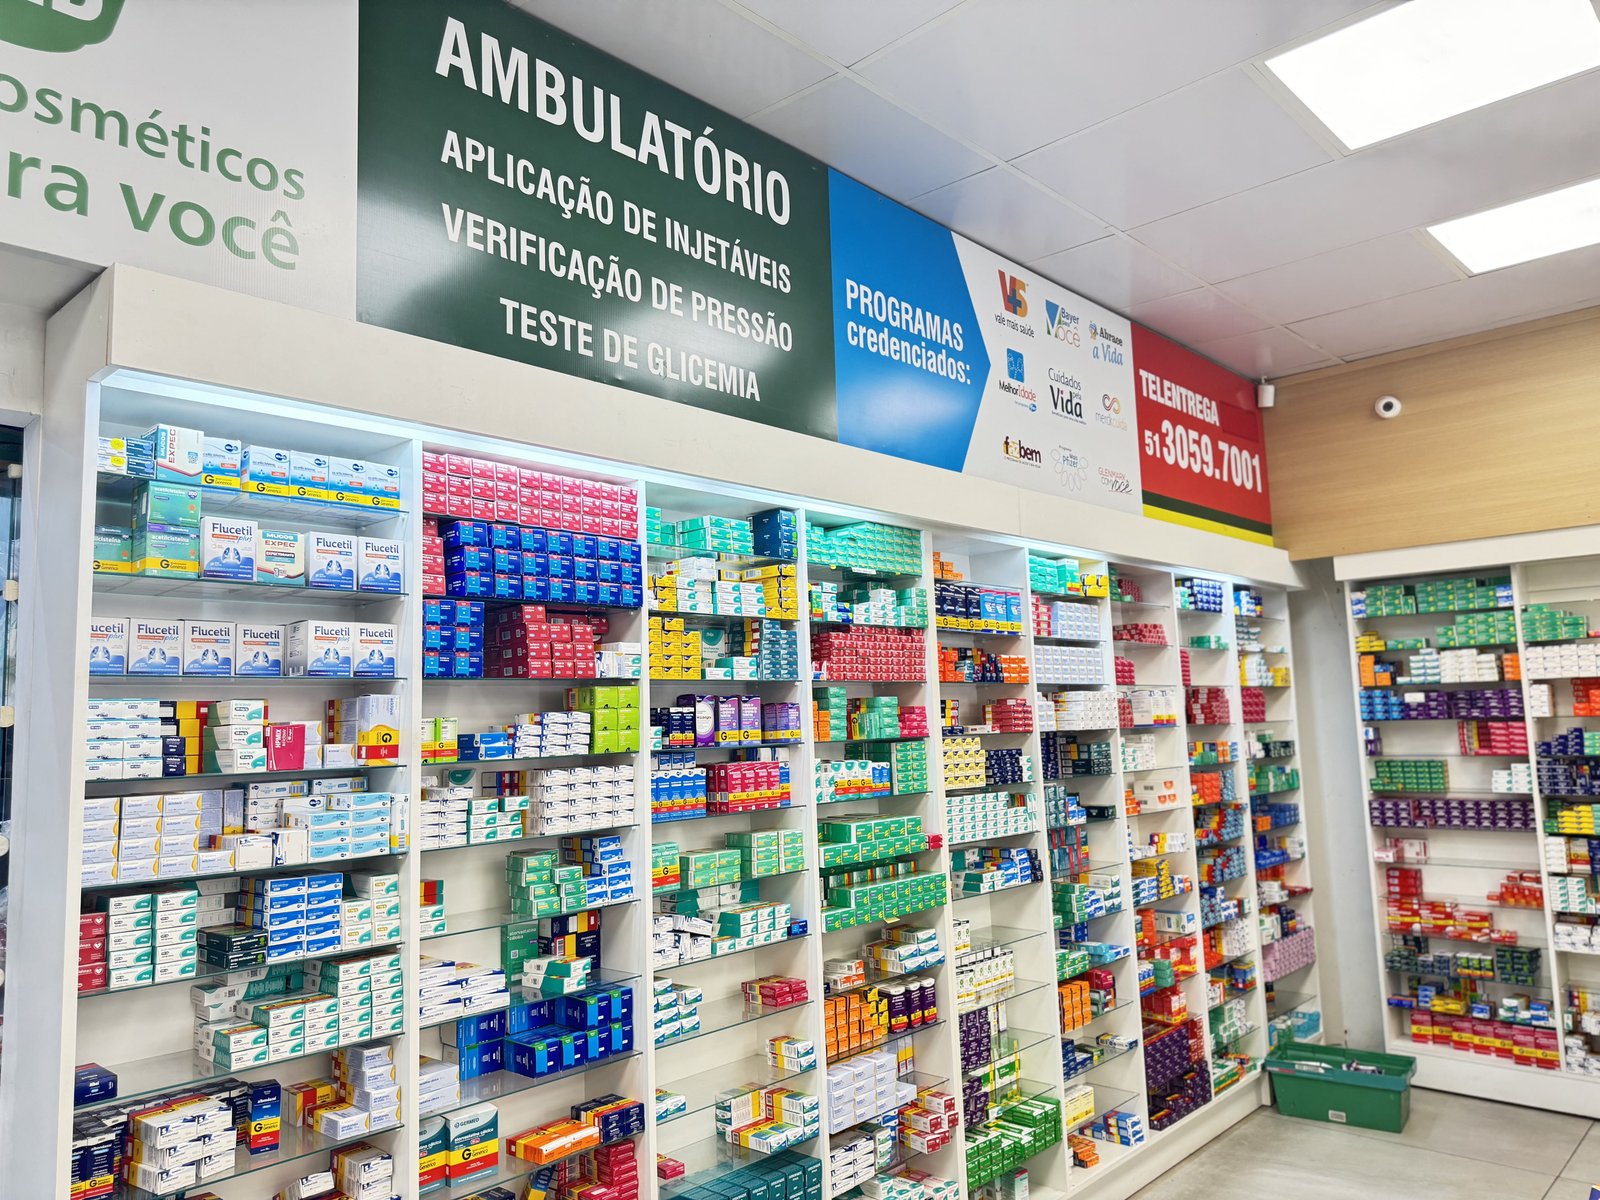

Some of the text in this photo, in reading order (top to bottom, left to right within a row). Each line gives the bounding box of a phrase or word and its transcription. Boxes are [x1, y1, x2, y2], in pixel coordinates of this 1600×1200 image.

[435, 16, 791, 226] AMBULATÓRIO
[7, 151, 299, 270] ra você
[441, 130, 791, 293] APLICAÇÃO DE INJETÁVEIS
[442, 203, 792, 352] VERIFICAÇÃO DE PRESSÃO
[846, 279, 963, 352] PROGRAMAS
[1061, 307, 1079, 324] Bayer
[995, 313, 1035, 338] vale mais saúde
[1100, 327, 1123, 346] Abrace
[500, 298, 760, 401] TESTE DE GLICEMIA
[847, 321, 971, 384] credenciados:
[1093, 343, 1123, 365] a Vida
[1048, 368, 1081, 390] Cuidados
[1050, 385, 1083, 419] Vida
[1139, 369, 1219, 427] TELENTREGA
[1145, 420, 1262, 493] 51 3059.7001
[204, 474, 215, 485] G
[256, 482, 266, 492] G
[298, 487, 306, 496] G
[336, 492, 344, 501] G
[372, 497, 380, 505] G
[212, 522, 253, 536] Flucetil
[238, 535, 253, 543] plus
[265, 540, 295, 548] EXPEC
[316, 537, 352, 550] Flucetil
[365, 542, 399, 553] Flucetil
[160, 559, 170, 569] G
[943, 618, 948, 626] G
[969, 620, 974, 628] G
[91, 623, 123, 633] ucetil
[137, 624, 179, 635] Flucetil
[191, 626, 230, 637] Flucetil
[314, 626, 350, 637] Flucetil
[360, 628, 393, 638] Flucetil
[243, 629, 280, 640] Flucetil
[382, 733, 392, 743] G
[721, 732, 727, 740] G
[743, 731, 749, 739] G
[663, 867, 669, 875] G
[254, 1123, 263, 1132] G
[460, 1118, 480, 1126] GERMED
[462, 1149, 471, 1160] G
